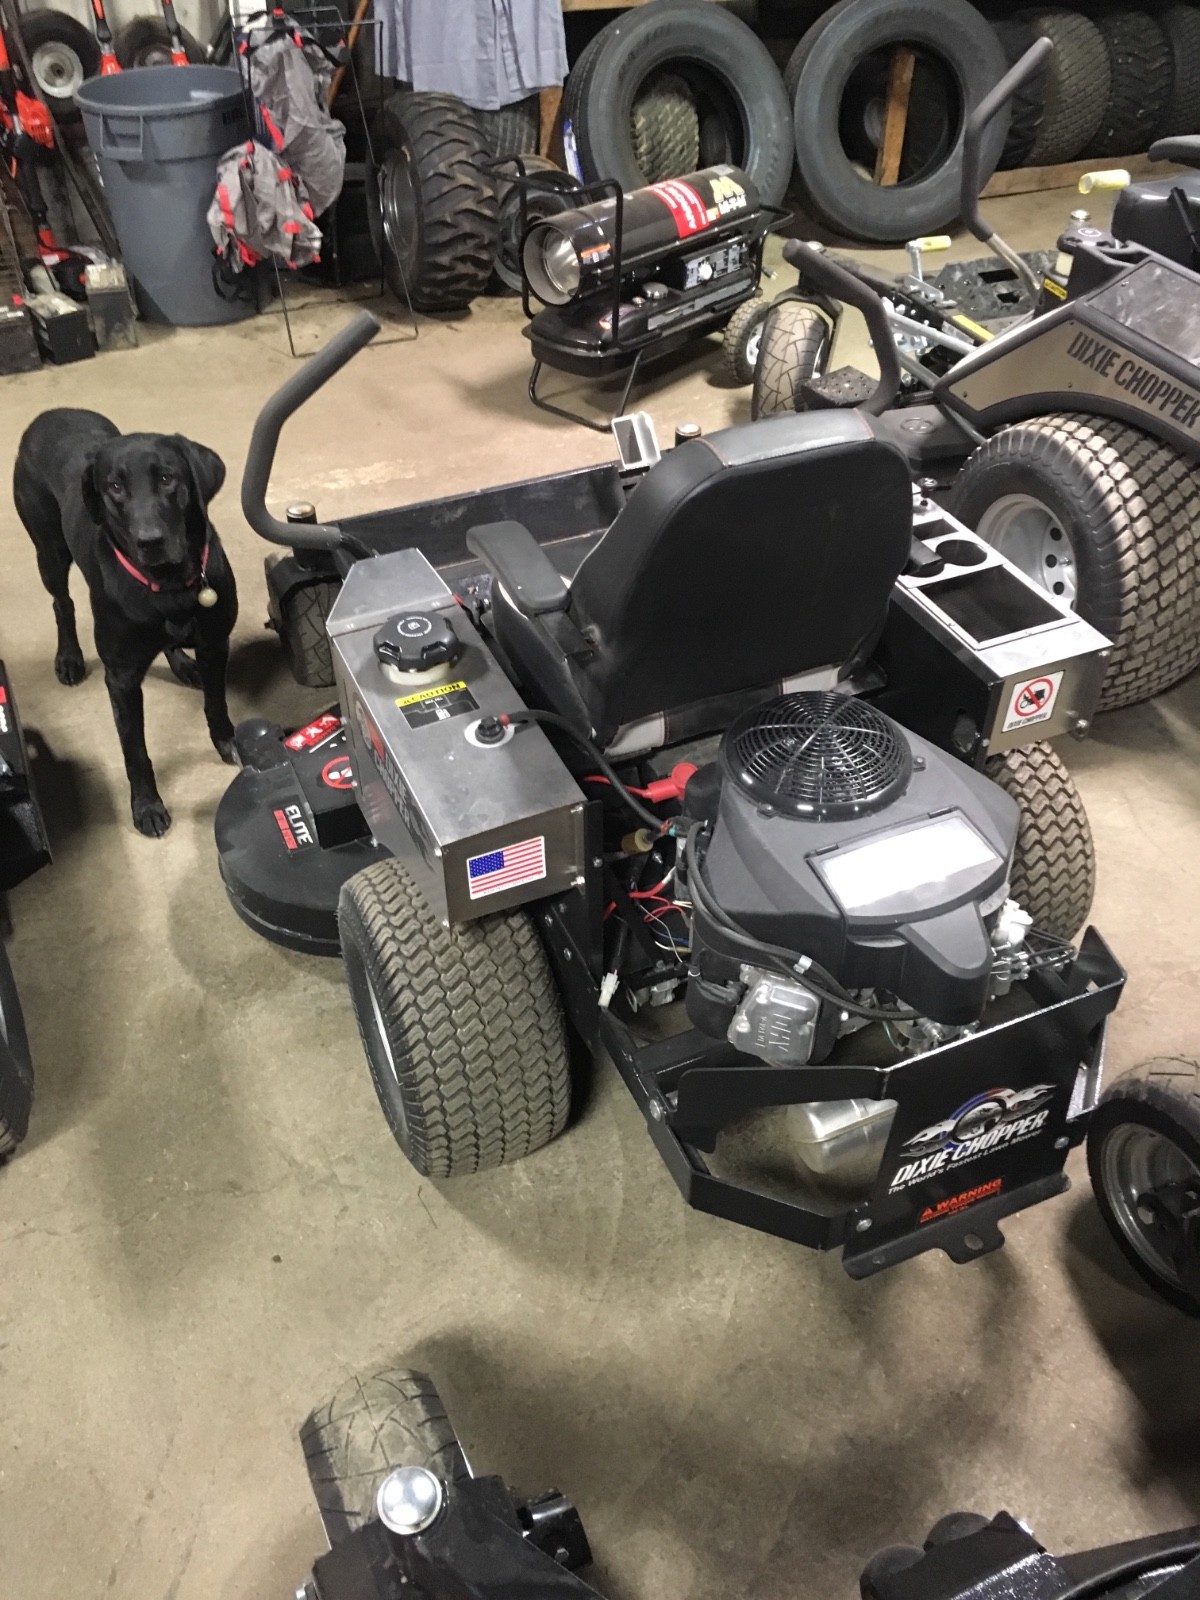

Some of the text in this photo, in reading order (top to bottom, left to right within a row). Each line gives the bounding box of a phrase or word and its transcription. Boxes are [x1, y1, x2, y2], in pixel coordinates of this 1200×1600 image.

[1066, 331, 1200, 428] DIXIE CHOPPER
[411, 684, 460, 703] CAUTION
[285, 804, 313, 844] ELITE
[888, 1129, 1042, 1195] The World's Fastest Lawn Mower
[891, 1110, 1048, 1186] DIXIE CHOPPER
[935, 1178, 1002, 1209] WARNING
